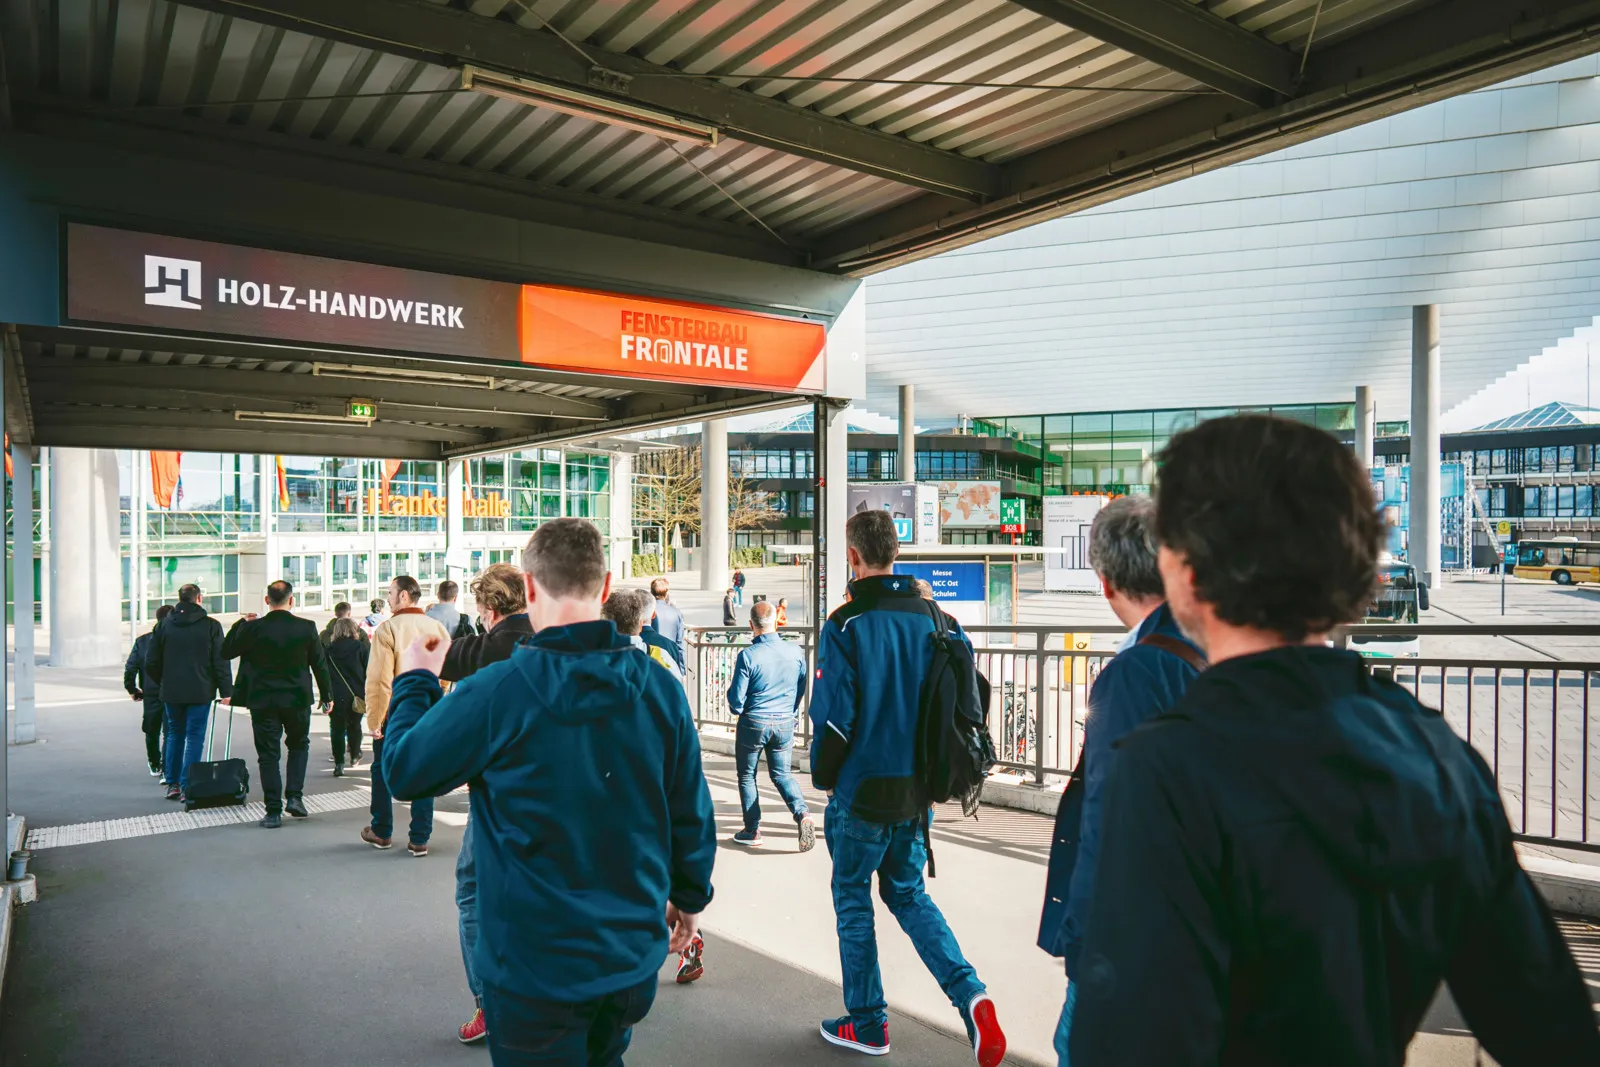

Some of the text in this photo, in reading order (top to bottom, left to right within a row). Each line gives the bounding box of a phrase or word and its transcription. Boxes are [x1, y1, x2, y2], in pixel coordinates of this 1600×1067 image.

[218, 278, 464, 329] HOLZ-HANDWERK
[621, 310, 748, 345] FENSTERBAU
[621, 334, 748, 371] FRONTALE
[932, 569, 953, 577] Messe
